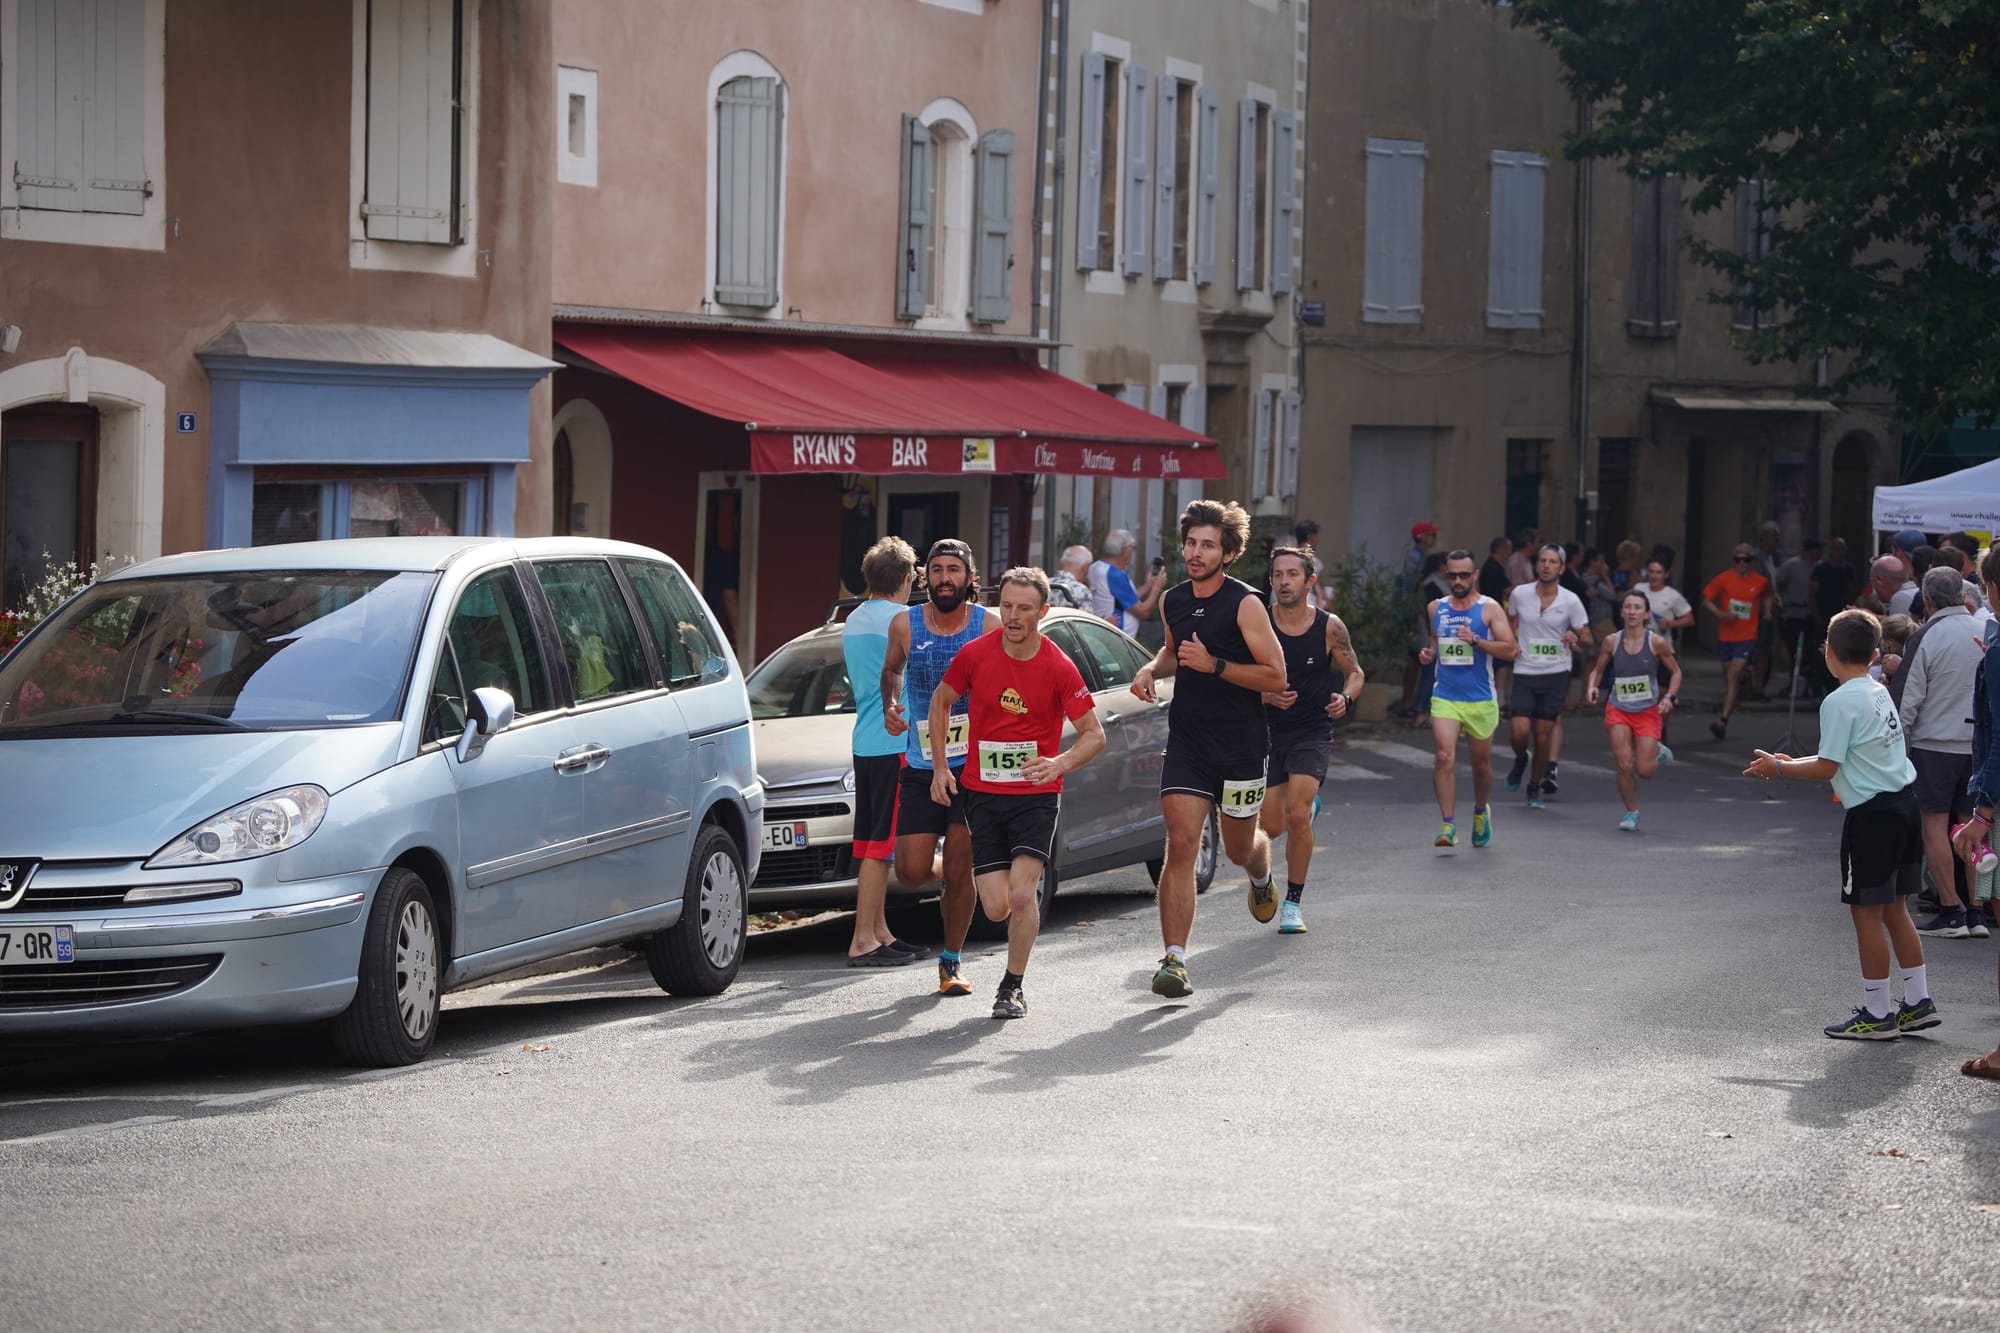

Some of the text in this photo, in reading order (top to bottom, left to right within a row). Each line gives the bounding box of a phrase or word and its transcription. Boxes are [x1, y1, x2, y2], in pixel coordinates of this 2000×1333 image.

[184, 415, 190, 430] 6
[793, 434, 928, 467] RYAN'S BAR
[1034, 442, 1180, 477] Chez Martine et John
[1445, 644, 1464, 656] 46
[1534, 645, 1557, 655] 105
[1620, 682, 1646, 694] 192
[988, 752, 1028, 769] 153
[1232, 786, 1264, 805] 185
[58, 944, 71, 957] 59
